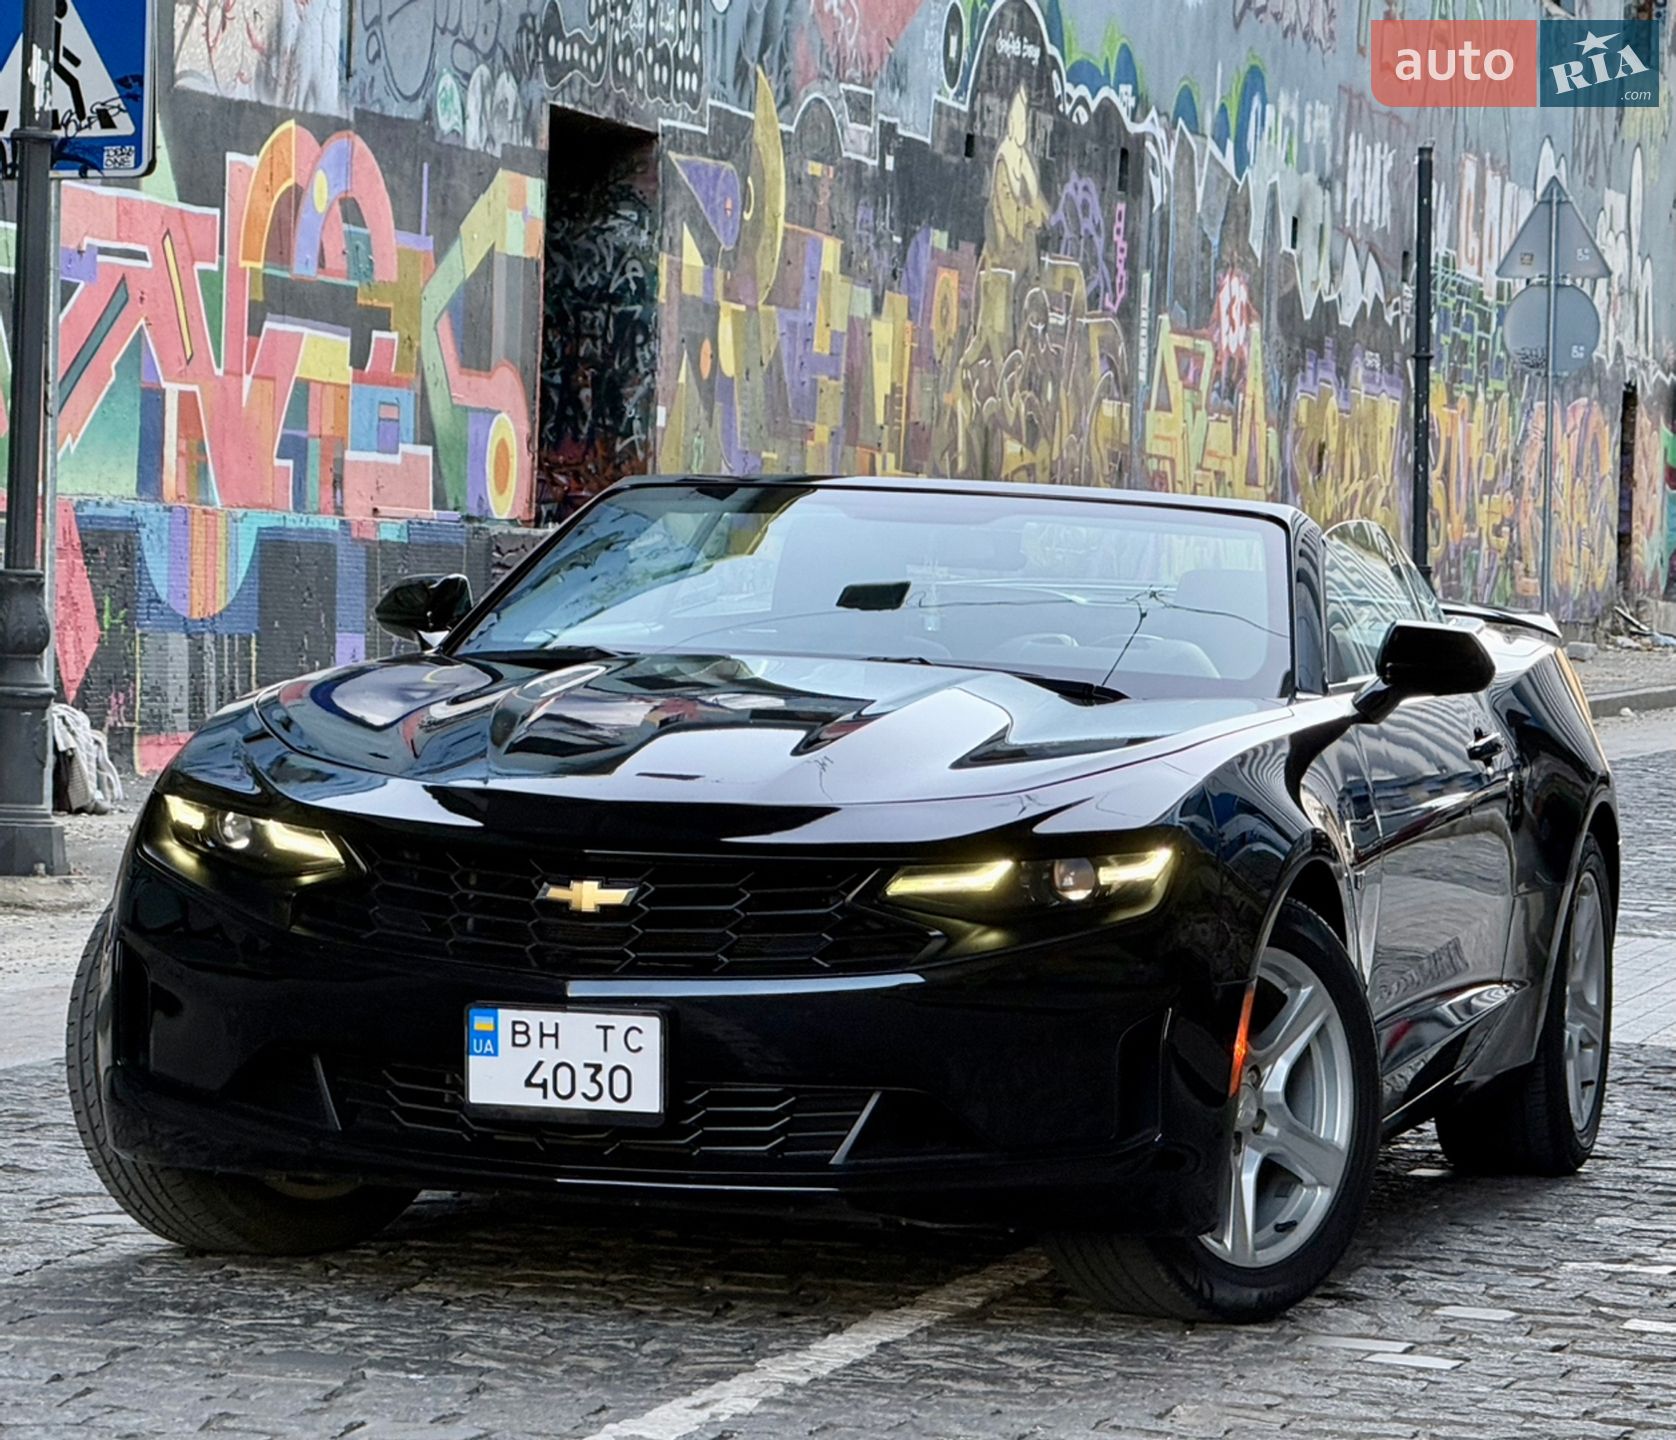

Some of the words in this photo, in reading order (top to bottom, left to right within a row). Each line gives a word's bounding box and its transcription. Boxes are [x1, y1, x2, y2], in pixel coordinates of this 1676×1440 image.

[472, 1039, 495, 1054] UA
[511, 1020, 559, 1050] BH
[595, 1024, 644, 1053] TC
[524, 1060, 633, 1104] 4030
